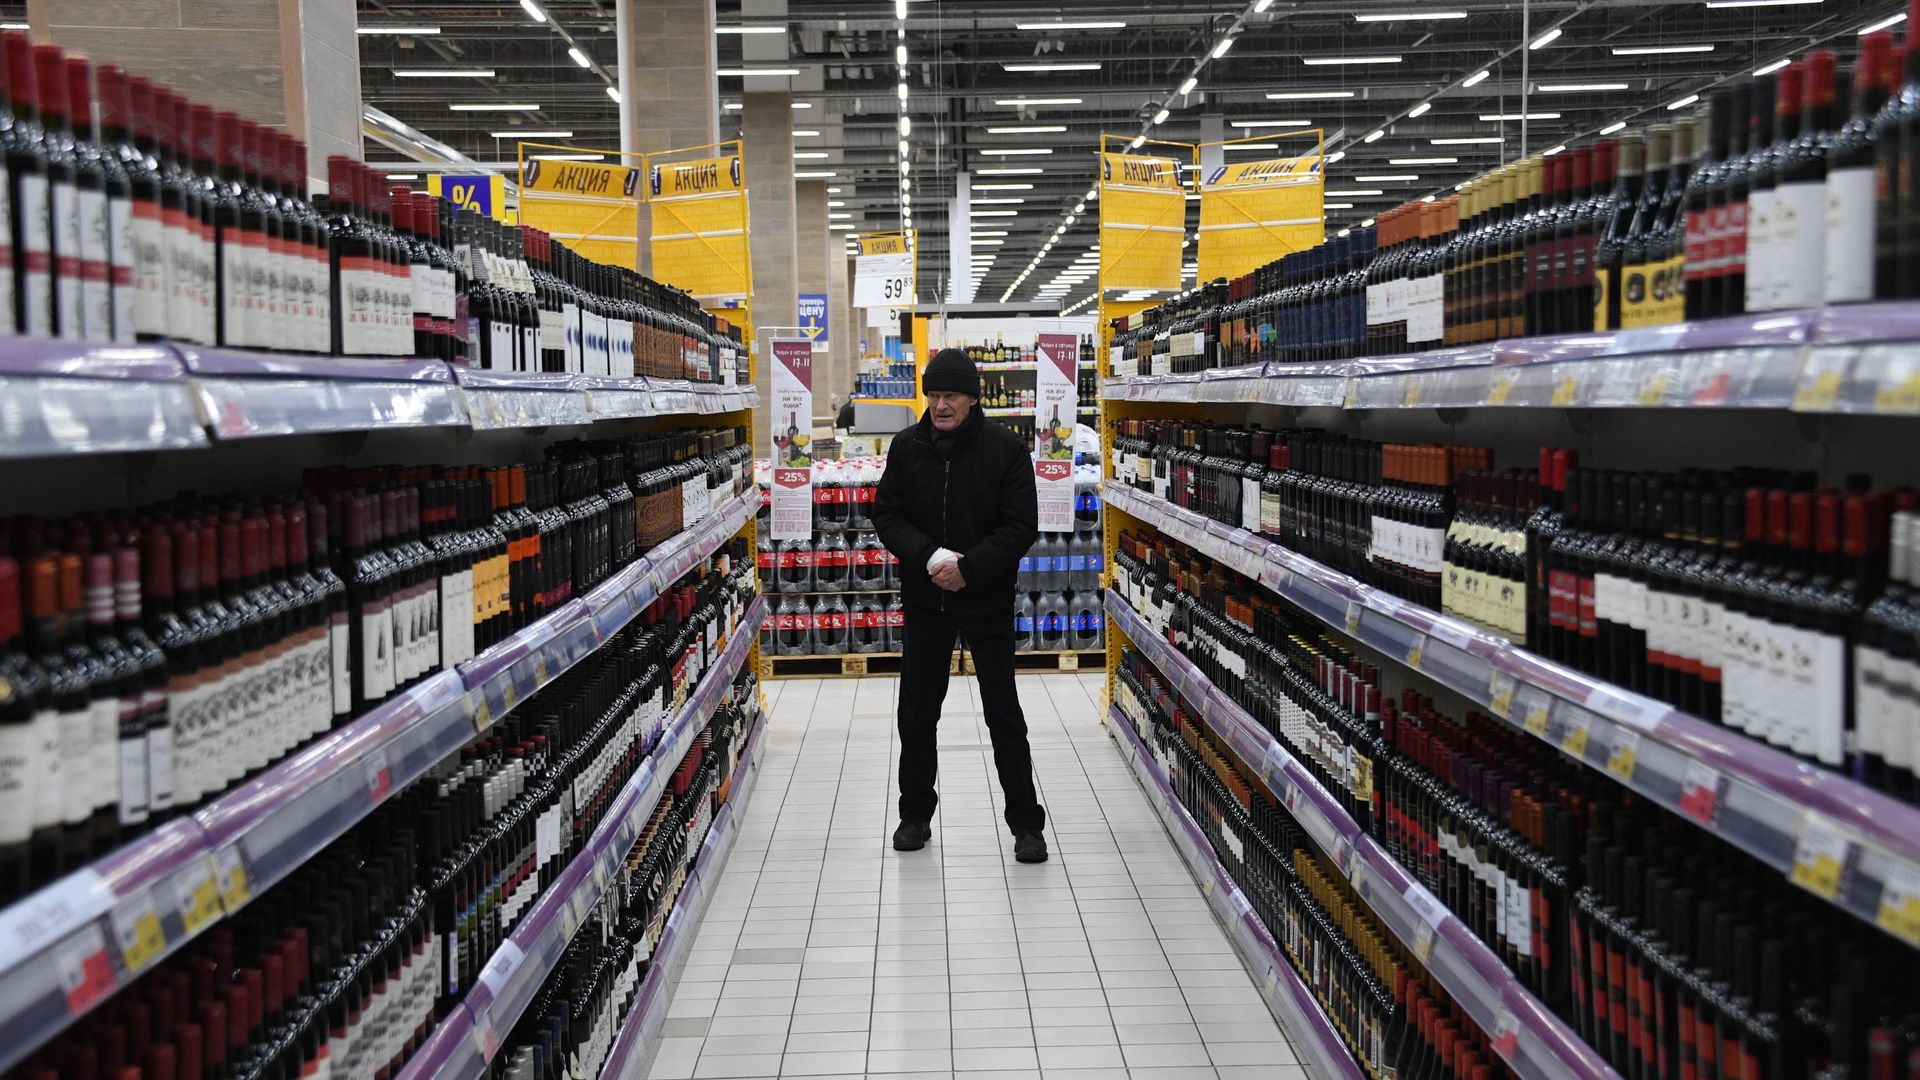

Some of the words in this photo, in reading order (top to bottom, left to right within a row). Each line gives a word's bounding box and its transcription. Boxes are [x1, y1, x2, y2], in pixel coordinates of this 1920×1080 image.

[675, 163, 718, 192] АКЦИЯ
[1124, 158, 1164, 184] АКЦИЯ
[1235, 161, 1296, 182] АКЦИЯ
[553, 166, 611, 193] АКЦИЯ
[871, 240, 898, 254] АКЦИЯ
[884, 278, 903, 299] 59
[799, 306, 825, 319] цену
[1057, 350, 1075, 361] 17.11
[792, 358, 810, 368] 17.11
[1039, 464, 1067, 475] -25%
[778, 472, 807, 483] -25%
